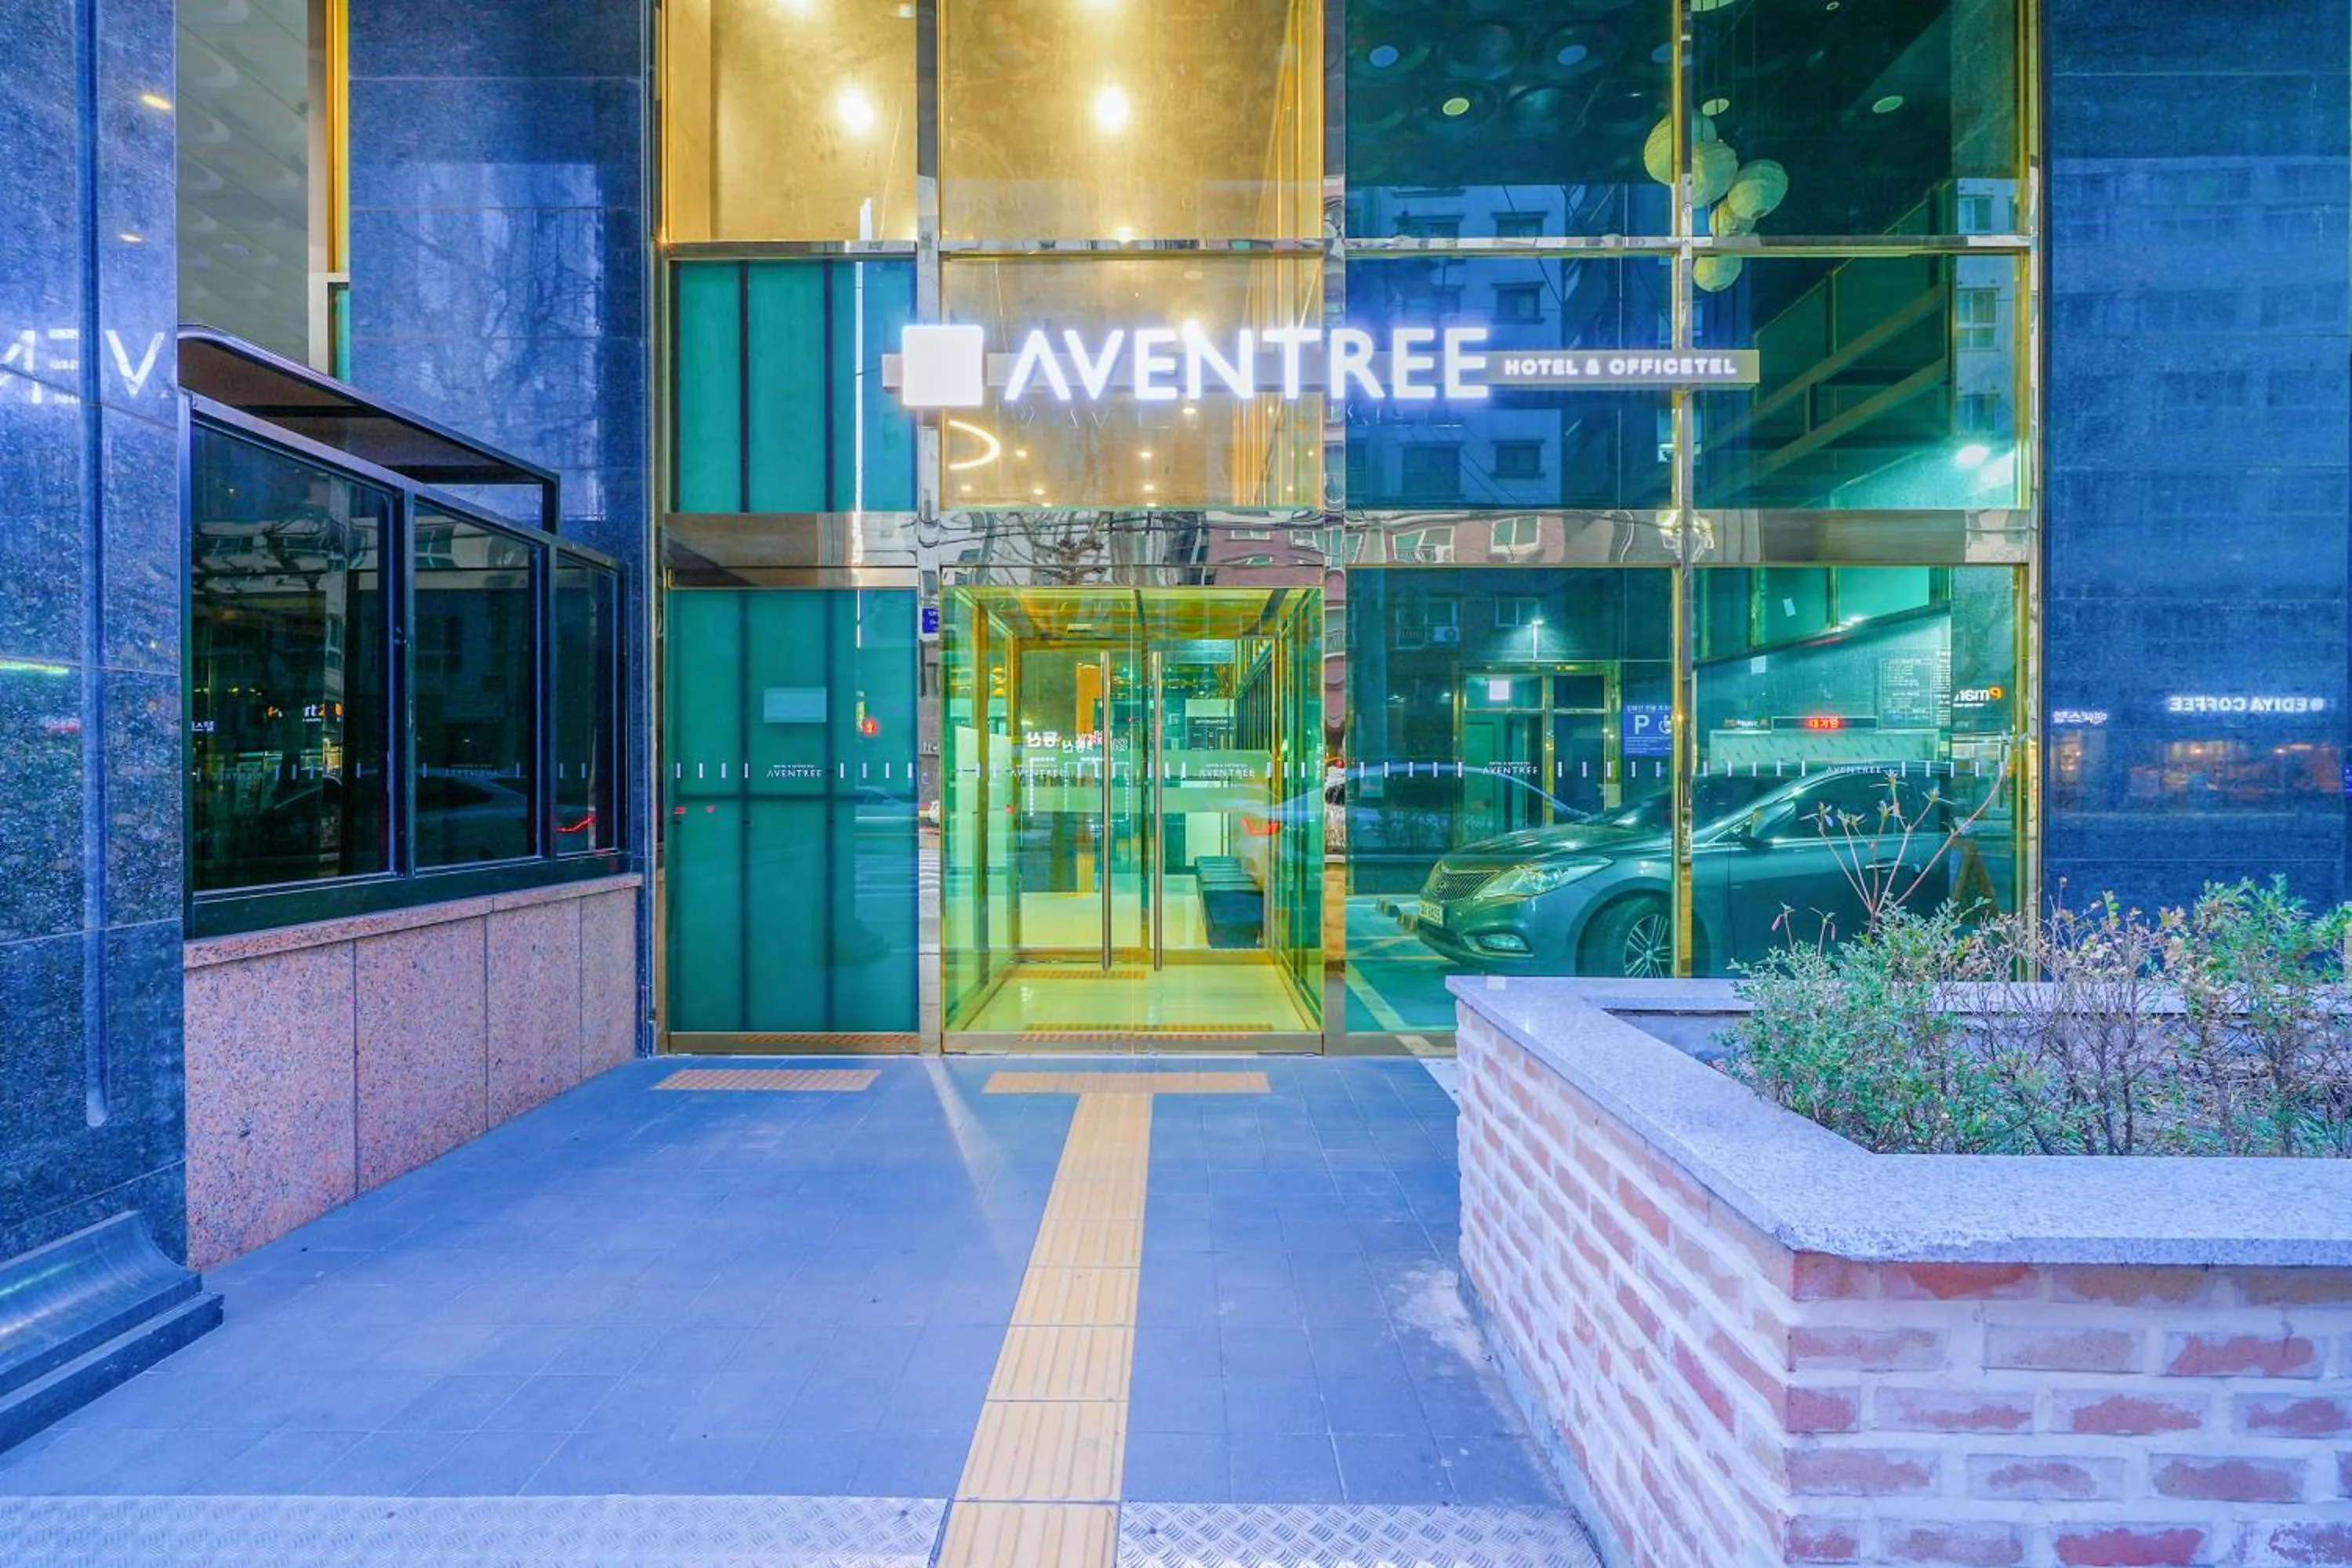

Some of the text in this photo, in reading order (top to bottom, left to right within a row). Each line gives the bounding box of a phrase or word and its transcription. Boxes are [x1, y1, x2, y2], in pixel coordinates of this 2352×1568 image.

[1004, 325, 1490, 402] AVENTREE
[1504, 358, 1737, 375] HOTEL & OFFICETEL
[1634, 714, 1650, 735] P
[765, 769, 822, 778] AVENTREE
[1482, 766, 1538, 775] AVENTREE
